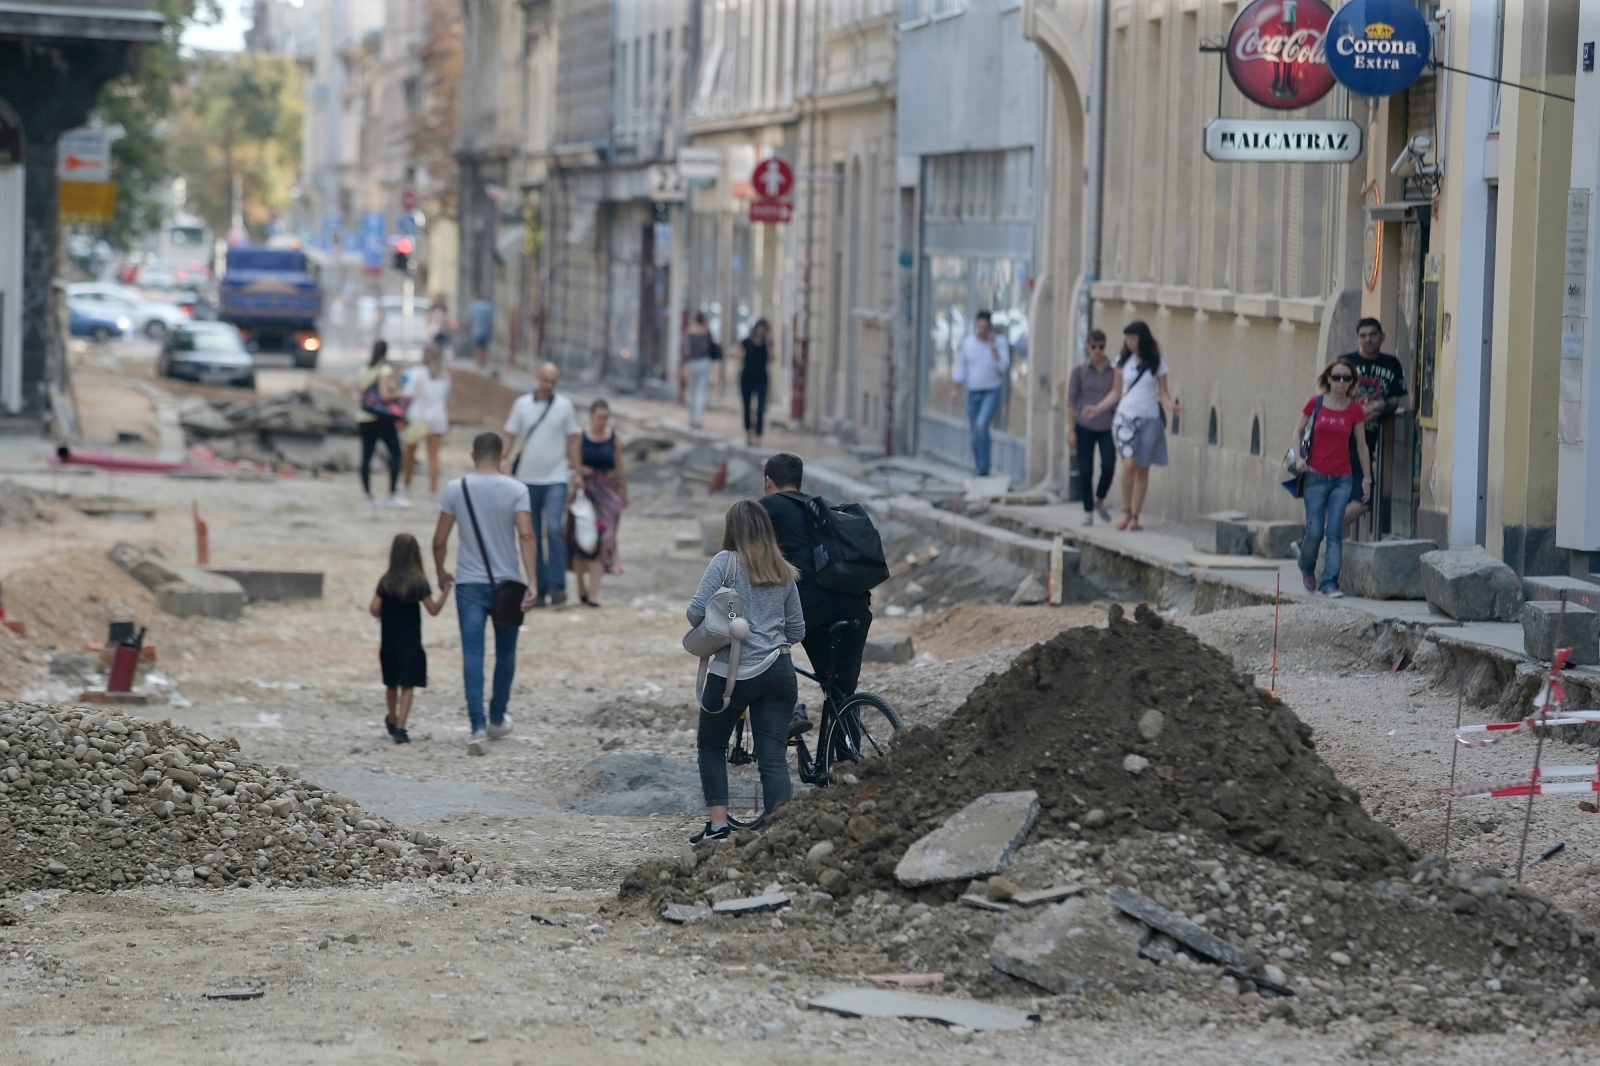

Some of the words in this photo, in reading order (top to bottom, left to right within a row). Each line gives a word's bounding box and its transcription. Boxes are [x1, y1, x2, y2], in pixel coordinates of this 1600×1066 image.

[1336, 35, 1416, 55] Corona
[1354, 55, 1400, 70] Extra
[1237, 132, 1349, 152] ALCATRAZ
